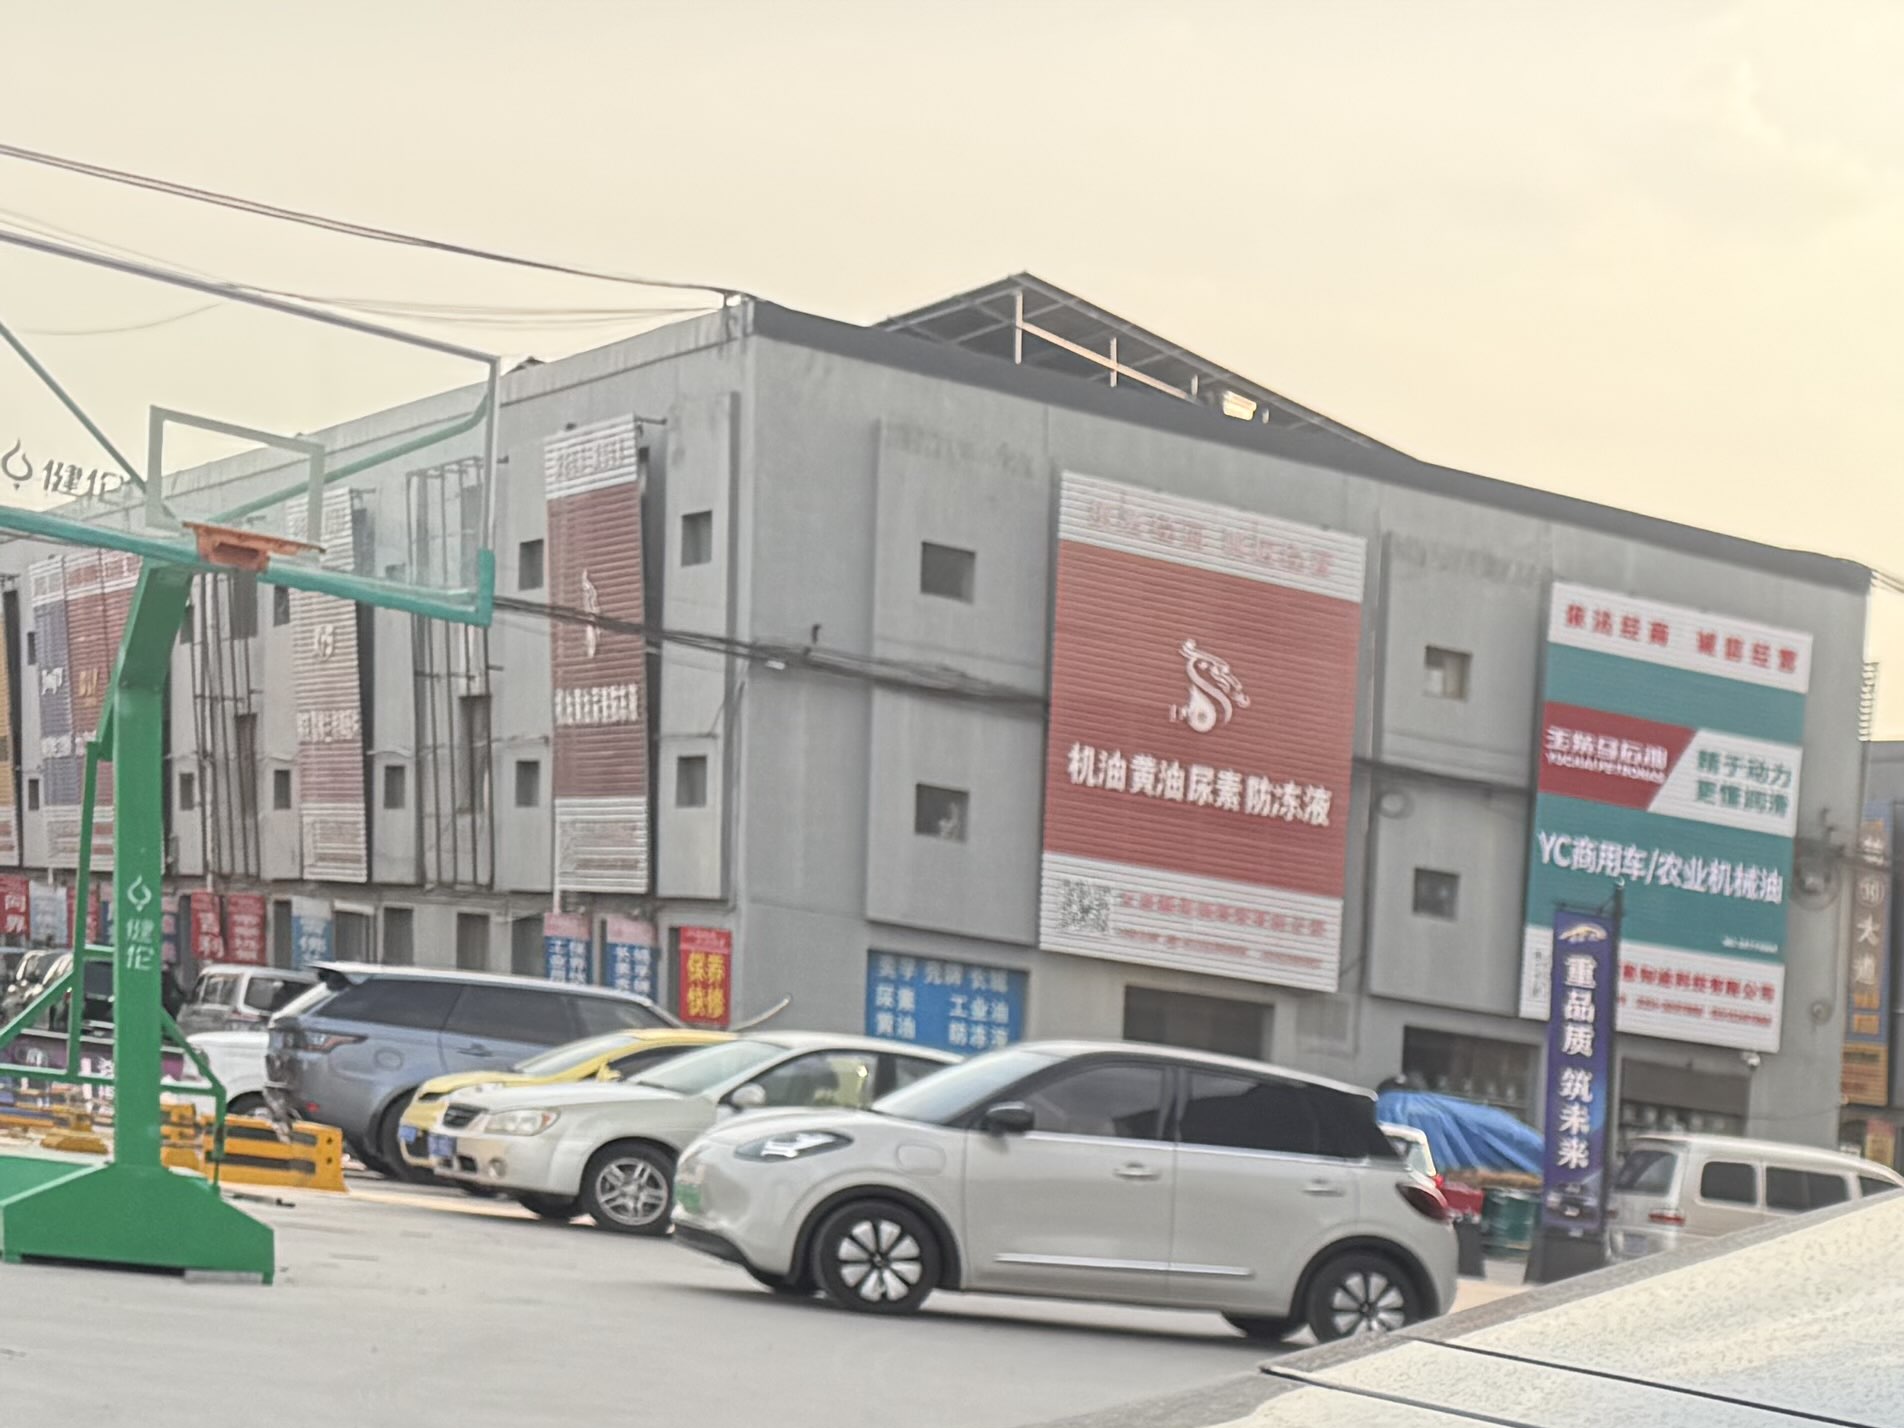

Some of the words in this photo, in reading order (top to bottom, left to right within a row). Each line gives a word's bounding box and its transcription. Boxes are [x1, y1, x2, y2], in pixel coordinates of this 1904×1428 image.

[1067, 742, 1333, 827] 机油黄油尿素防冻液
[1537, 830, 1784, 904] YC商用车/农业机械油
[1561, 954, 1598, 1058] 重品质
[1557, 1067, 1593, 1170] 筑未来
